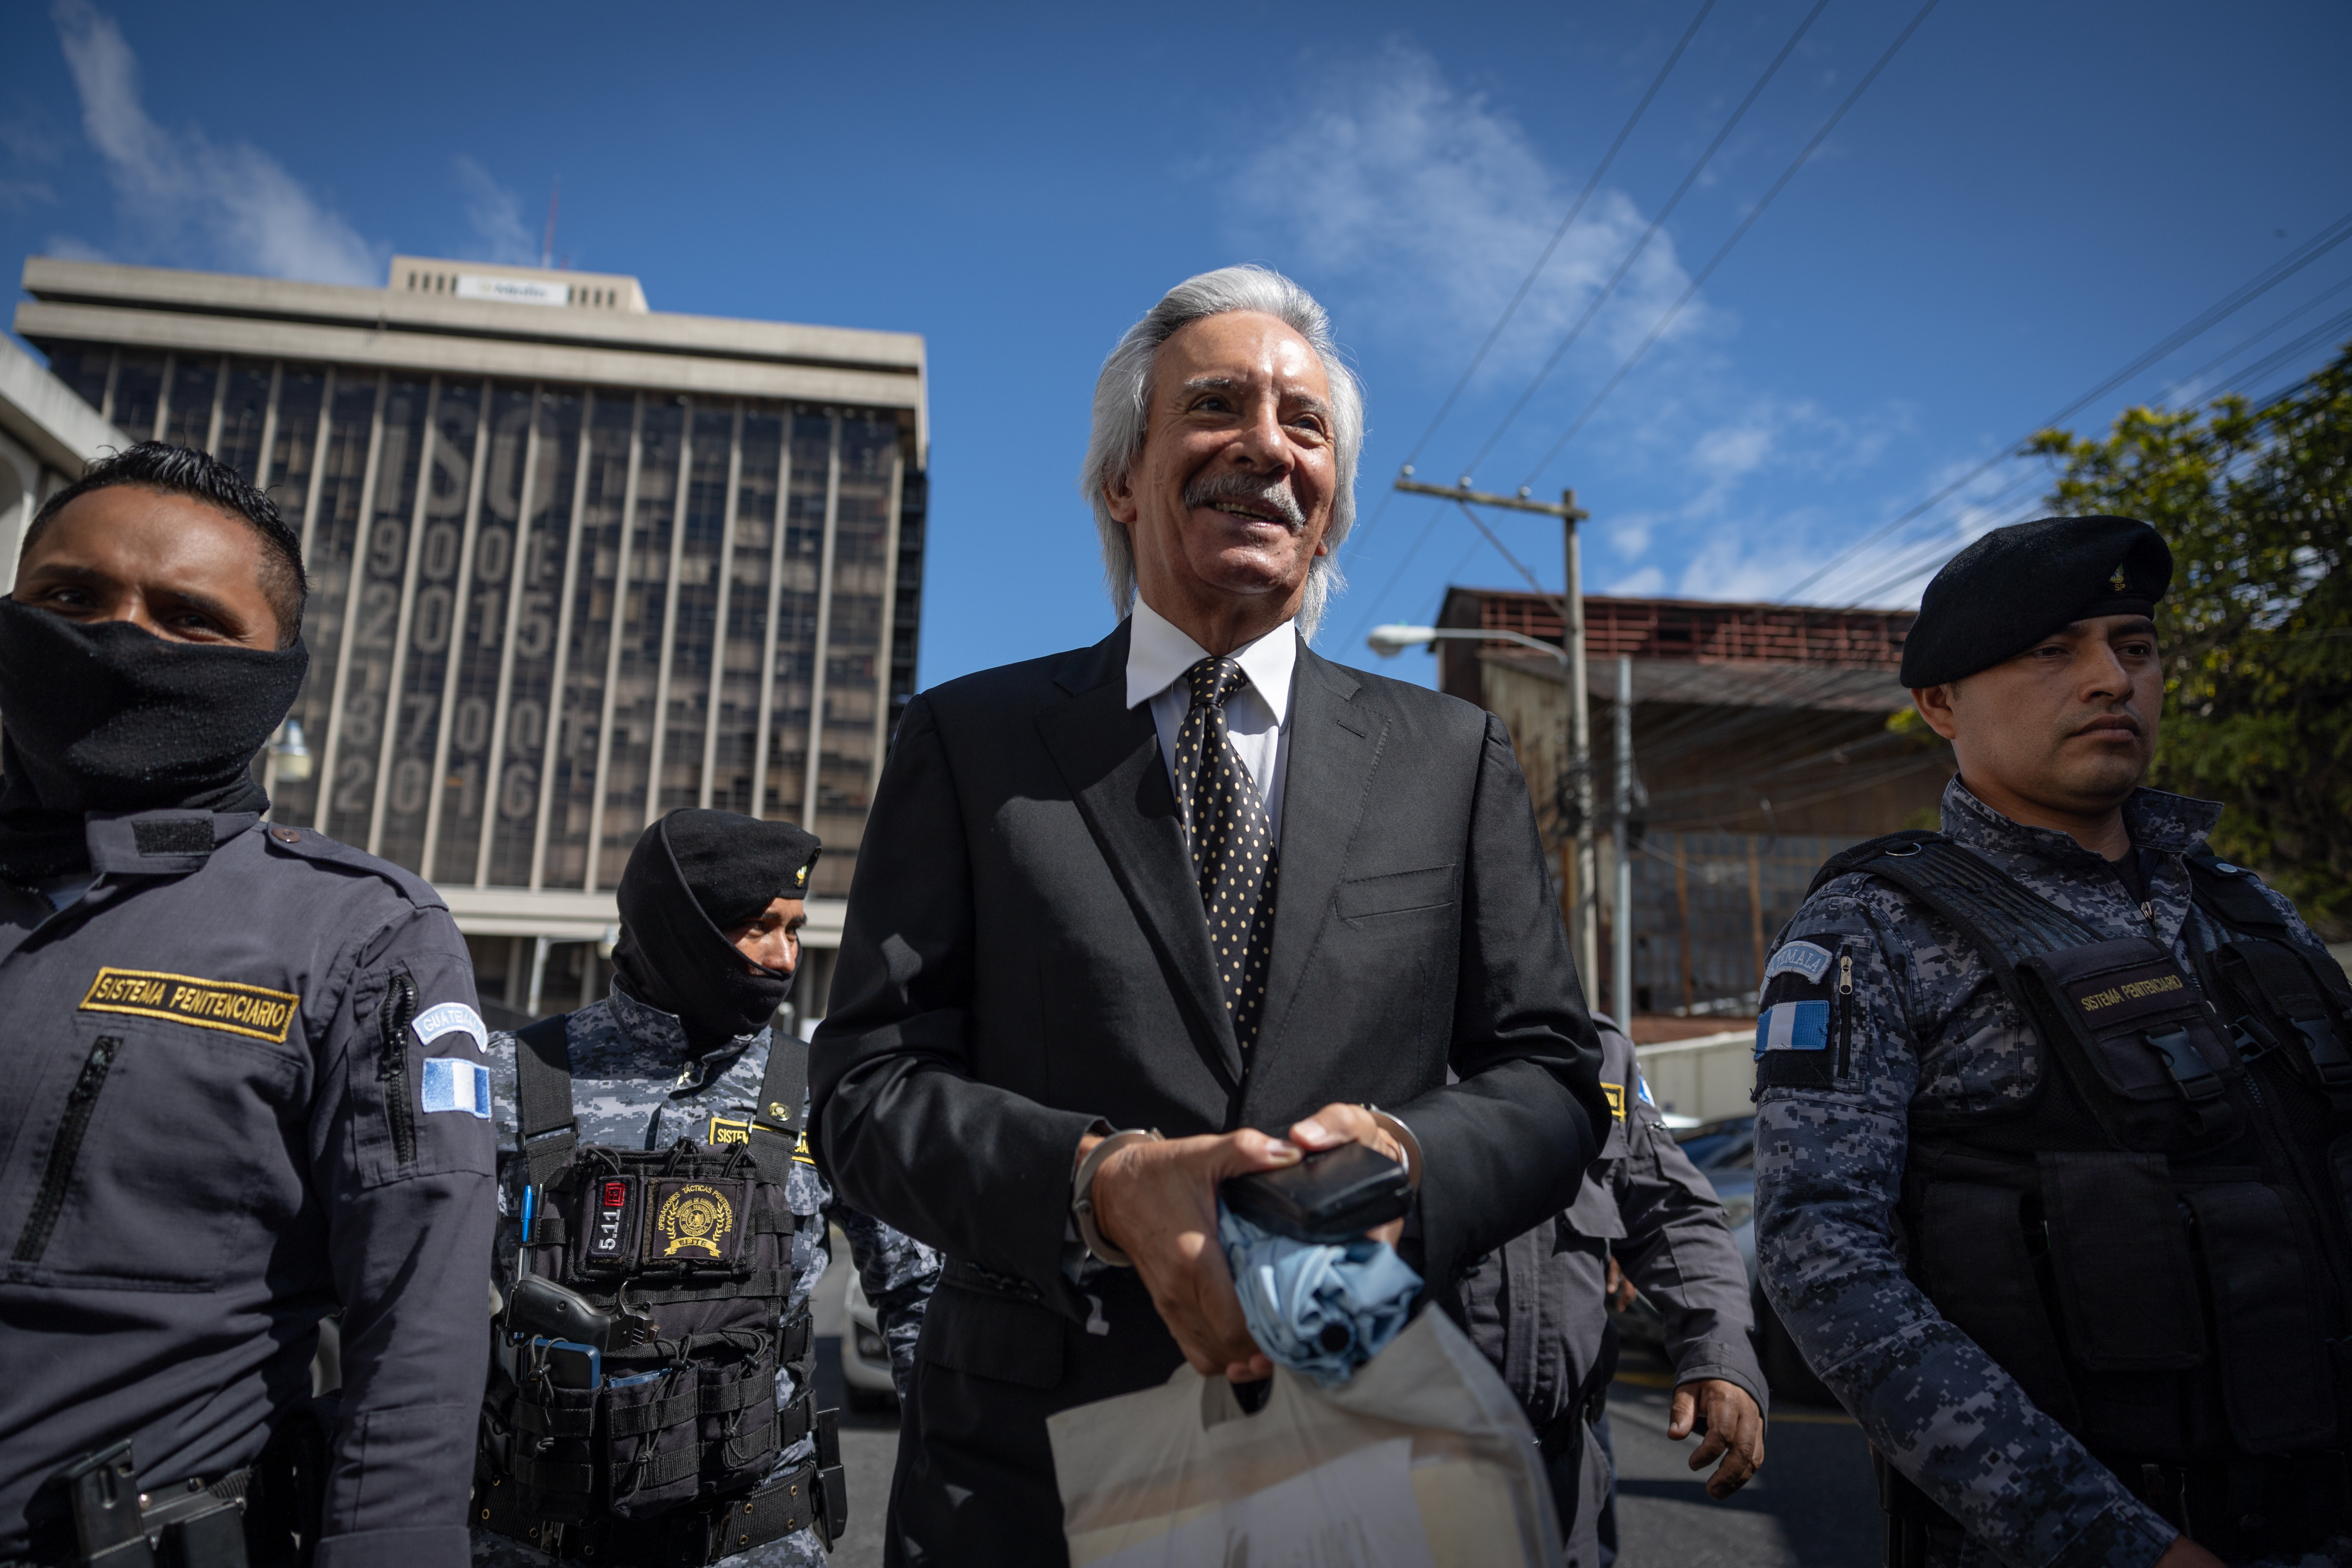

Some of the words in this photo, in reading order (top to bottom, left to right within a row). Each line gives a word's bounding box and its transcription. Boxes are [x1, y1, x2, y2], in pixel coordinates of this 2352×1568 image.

[375, 397, 561, 523] ISO
[355, 581, 554, 658] 2015
[334, 754, 537, 819] 2016
[95, 976, 167, 1006] SISTEMA
[169, 985, 287, 1029] PENITENCIARIO
[2081, 987, 2125, 1011] SISTEMA
[2120, 975, 2183, 999] PENITENCIARIO
[423, 1009, 483, 1041] GUATEMALA
[598, 1209, 621, 1250] 5.11
[658, 1192, 680, 1230] OPERACIONES
[681, 1184, 712, 1194] TÁCTICAS
[712, 1190, 733, 1232] PENITENCIARIAS
[682, 1224, 708, 1235] GUATEMALA
